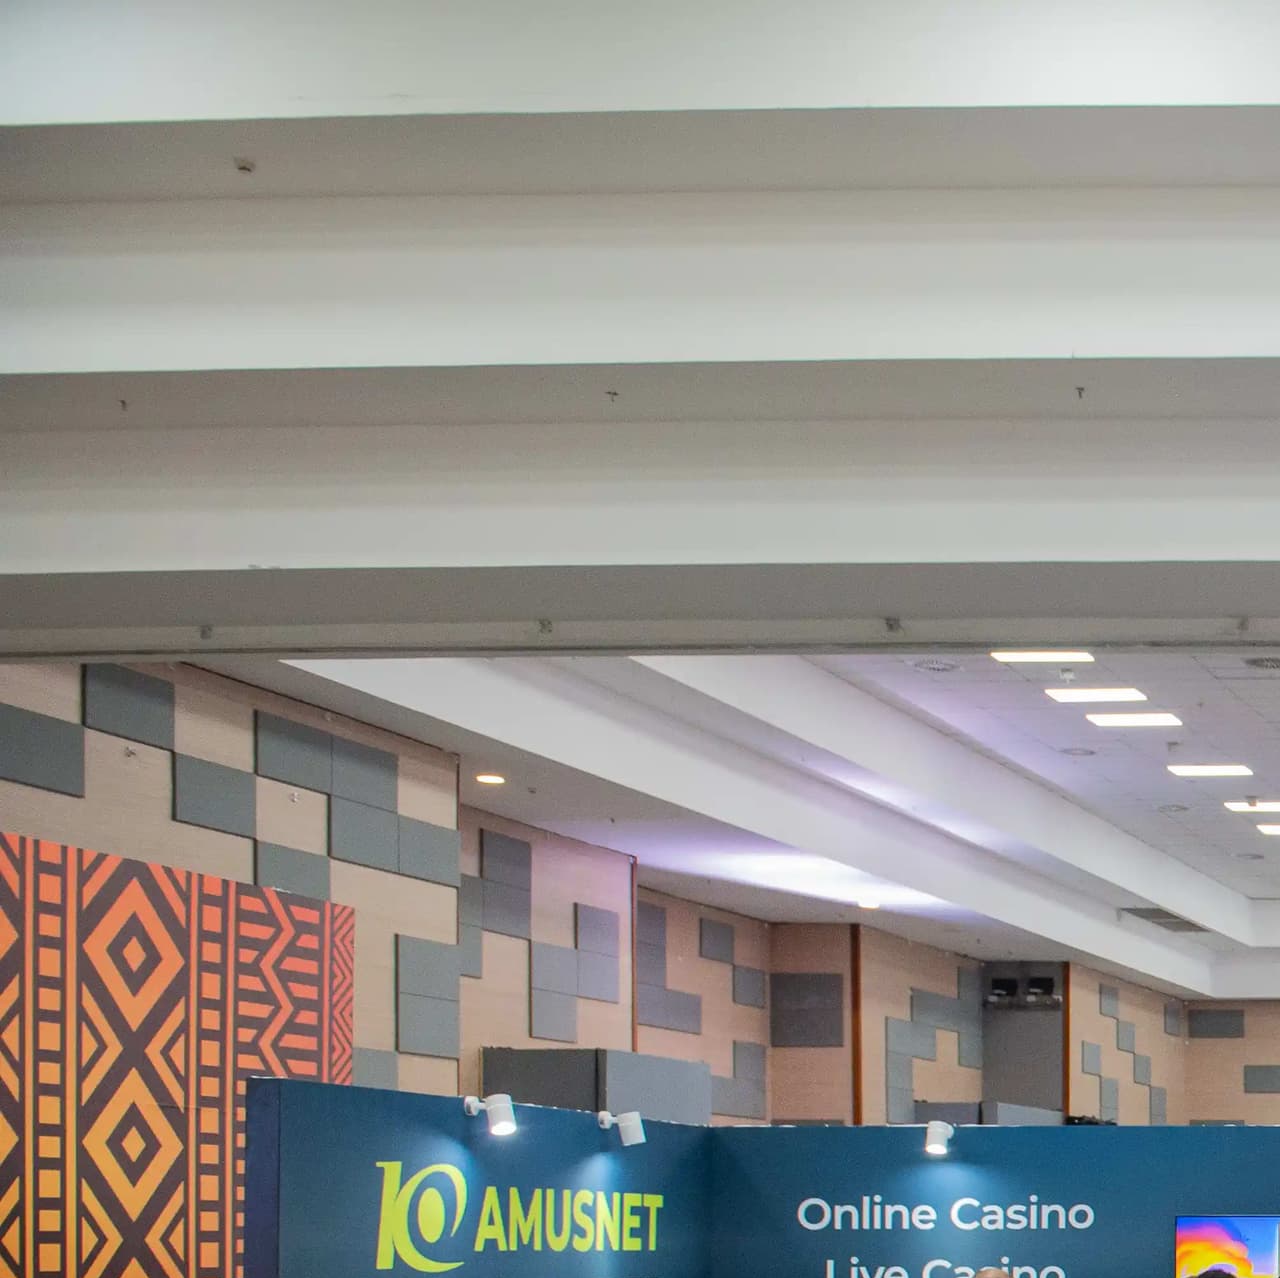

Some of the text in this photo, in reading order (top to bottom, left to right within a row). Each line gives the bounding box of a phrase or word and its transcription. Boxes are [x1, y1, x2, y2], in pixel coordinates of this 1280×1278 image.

[474, 1185, 665, 1253] AMUSNET
[797, 1194, 1096, 1231] Online Casino
